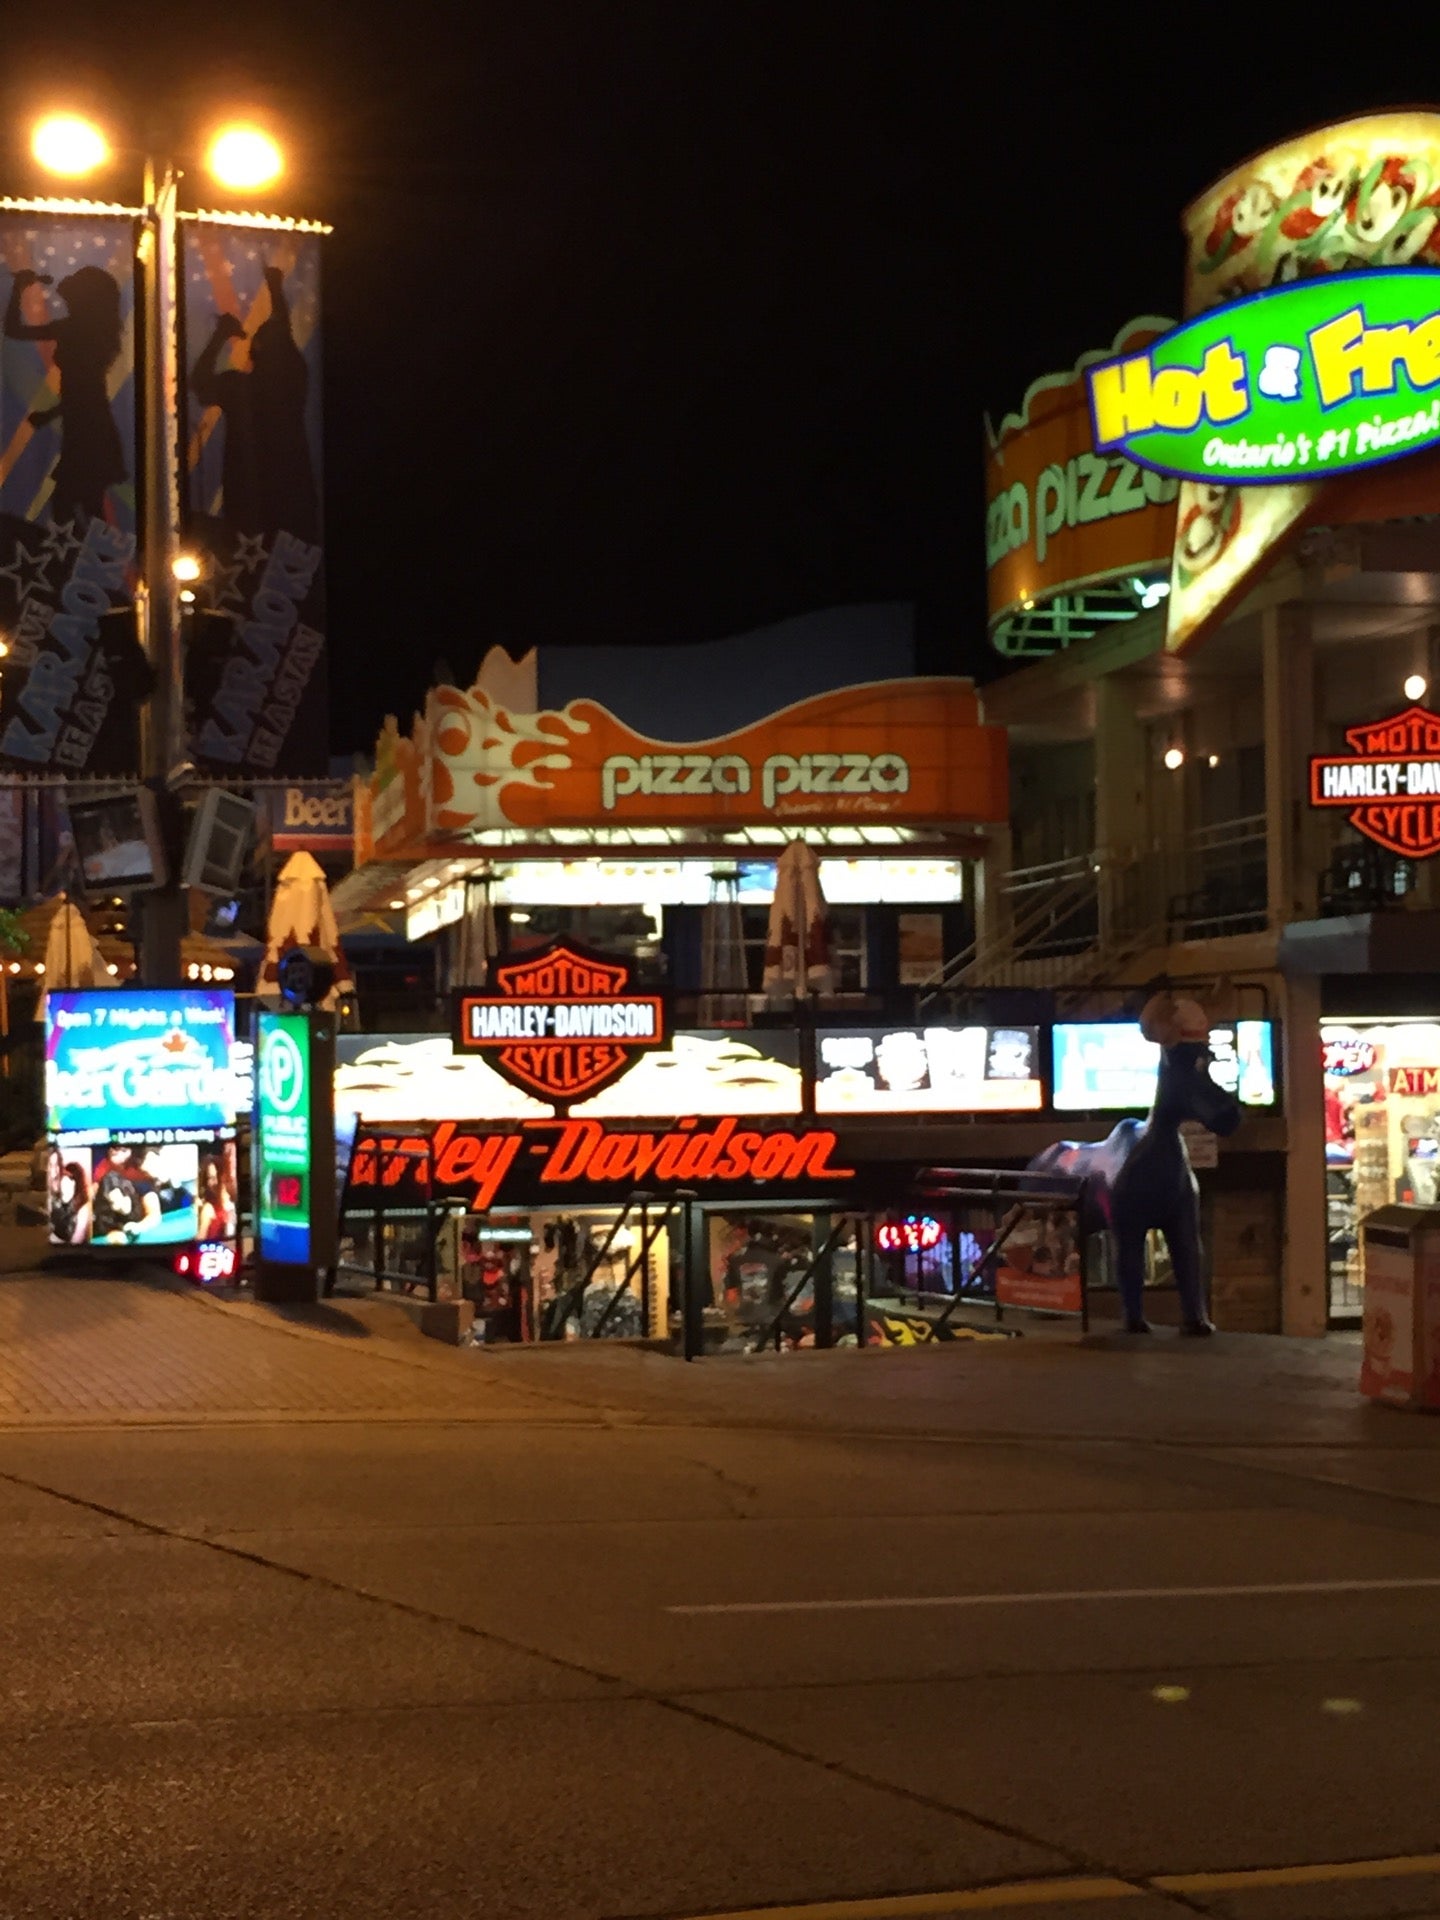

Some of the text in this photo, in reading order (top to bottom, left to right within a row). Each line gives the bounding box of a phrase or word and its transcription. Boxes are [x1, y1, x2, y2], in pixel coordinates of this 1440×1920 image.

[1089, 309, 1440, 447] Hot & Fre
[1203, 432, 1312, 468] Ontario's
[1317, 428, 1351, 461] #1
[1, 516, 136, 763] KARAOKE
[198, 529, 323, 764] KARAOKE
[1367, 717, 1440, 753] MOTO
[602, 754, 909, 810] pizza pizza
[284, 788, 349, 826] Beer
[516, 959, 611, 995] MOTOR
[94, 1008, 107, 1025] 7
[471, 1003, 654, 1038] HARLEY-DAVIDSON
[271, 1045, 293, 1098] P
[514, 1046, 612, 1087] CYCLES
[1393, 1070, 1440, 1097] ATM
[352, 1117, 855, 1210] arley-Davidson
